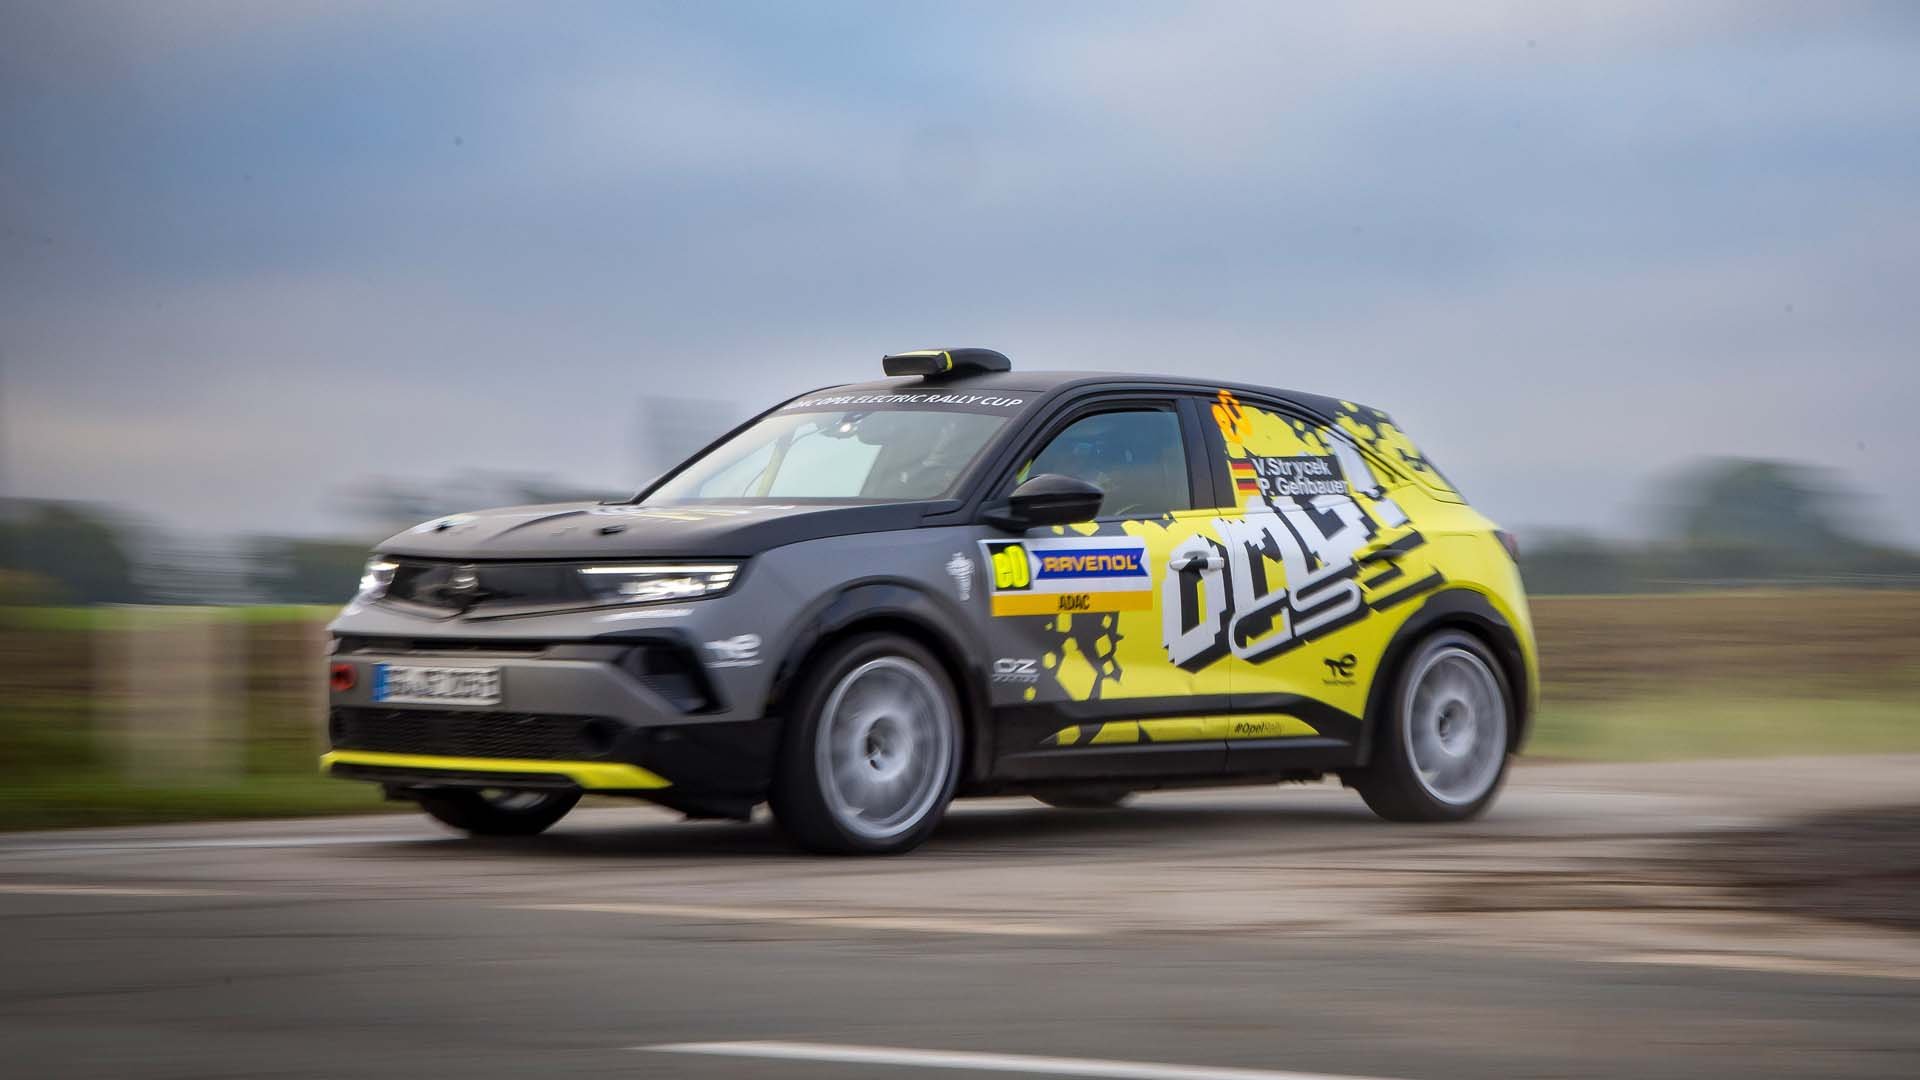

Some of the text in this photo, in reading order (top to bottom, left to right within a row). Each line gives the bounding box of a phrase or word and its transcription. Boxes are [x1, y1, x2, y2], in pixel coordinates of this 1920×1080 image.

[855, 394, 924, 404] ELECTRIC
[926, 394, 979, 404] RALLY
[980, 396, 1023, 408] CUP
[1043, 555, 1140, 572] RAVENOL
[1058, 594, 1091, 610] ADAC
